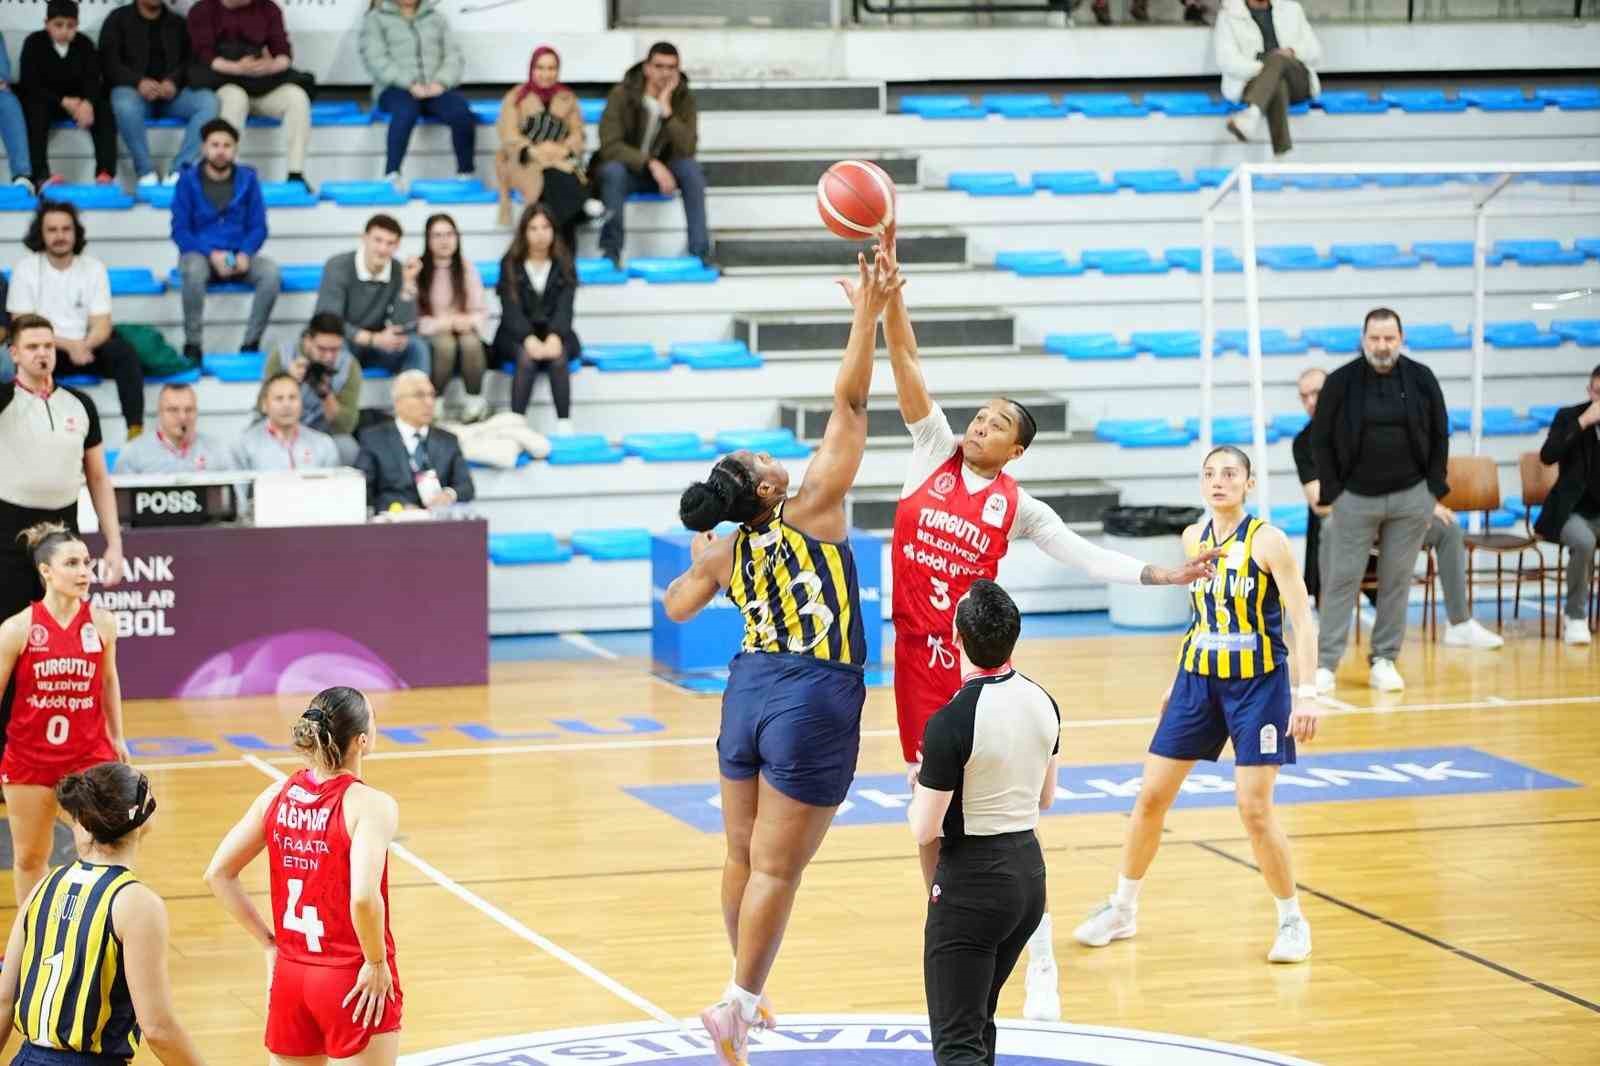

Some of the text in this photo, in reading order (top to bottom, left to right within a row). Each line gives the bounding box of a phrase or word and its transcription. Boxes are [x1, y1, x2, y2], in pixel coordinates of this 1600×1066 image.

[135, 490, 202, 514] POSS.
[918, 508, 991, 554] TURGUTLU
[82, 590, 176, 610] ADINLAR
[928, 576, 951, 611] 3
[1229, 575, 1255, 598] VIP
[33, 658, 96, 679] TURGUTLU
[46, 714, 70, 745] 0
[283, 878, 325, 952] 4
[31, 951, 64, 1047] 1
